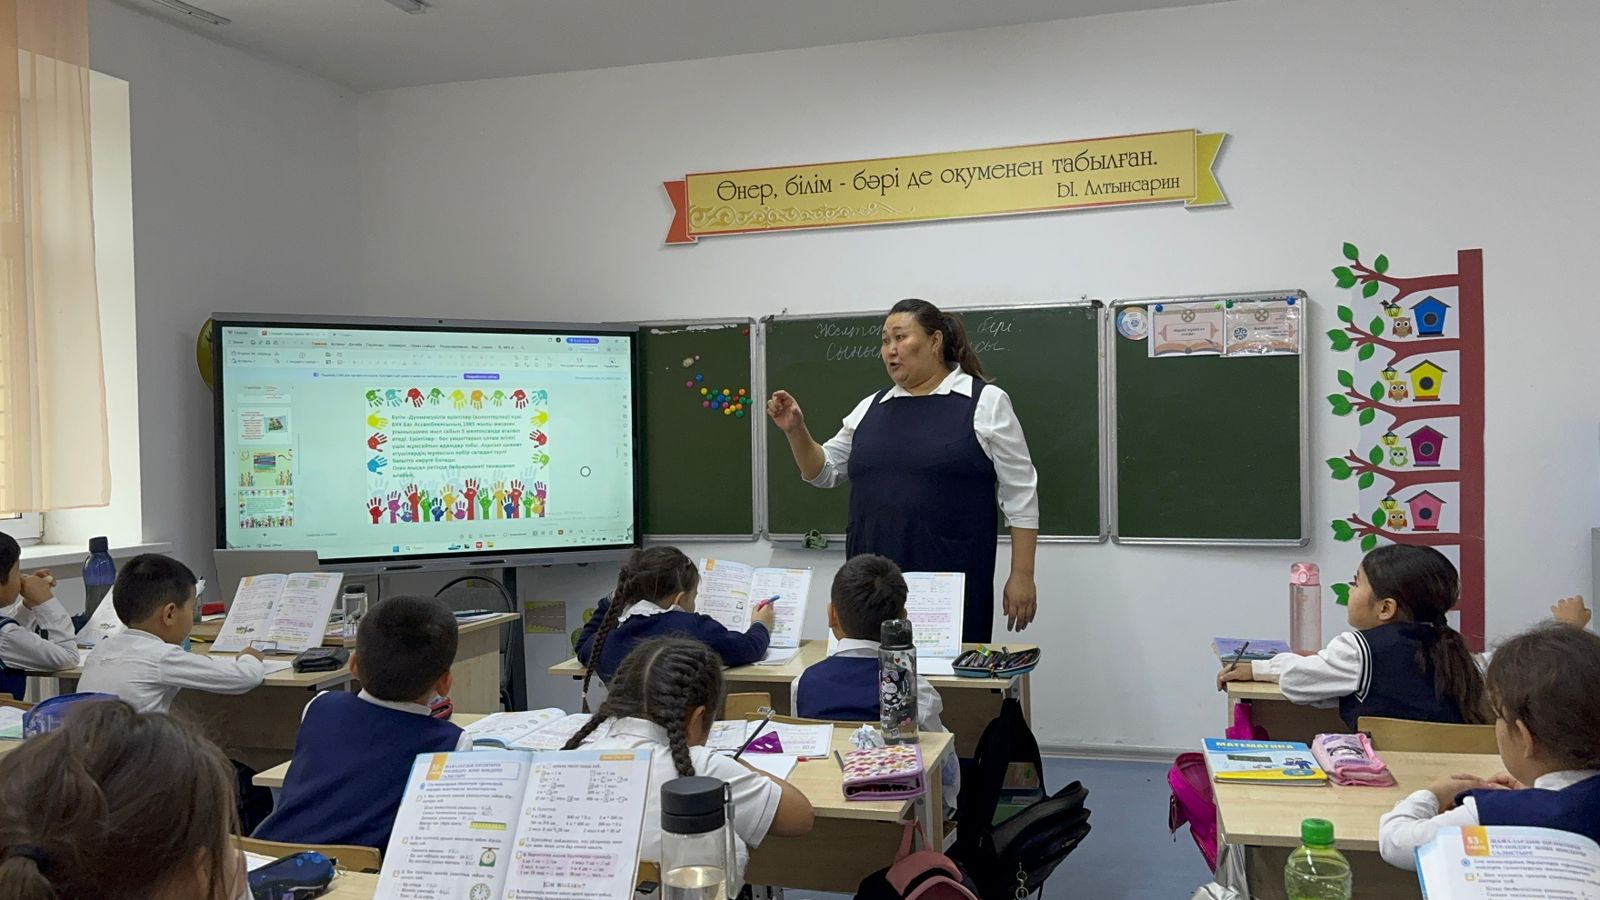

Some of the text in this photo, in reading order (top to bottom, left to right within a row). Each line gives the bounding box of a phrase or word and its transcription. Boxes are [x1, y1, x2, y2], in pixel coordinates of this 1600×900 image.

[717, 180, 778, 205] Өнер,
[785, 174, 832, 196] білім
[853, 168, 900, 196] бәрі
[907, 170, 932, 189] де
[1052, 149, 1158, 174] табылған.
[1057, 176, 1181, 198] Ы. Алтынсарин
[1215, 742, 1295, 750] МАТЕМАТИКА
